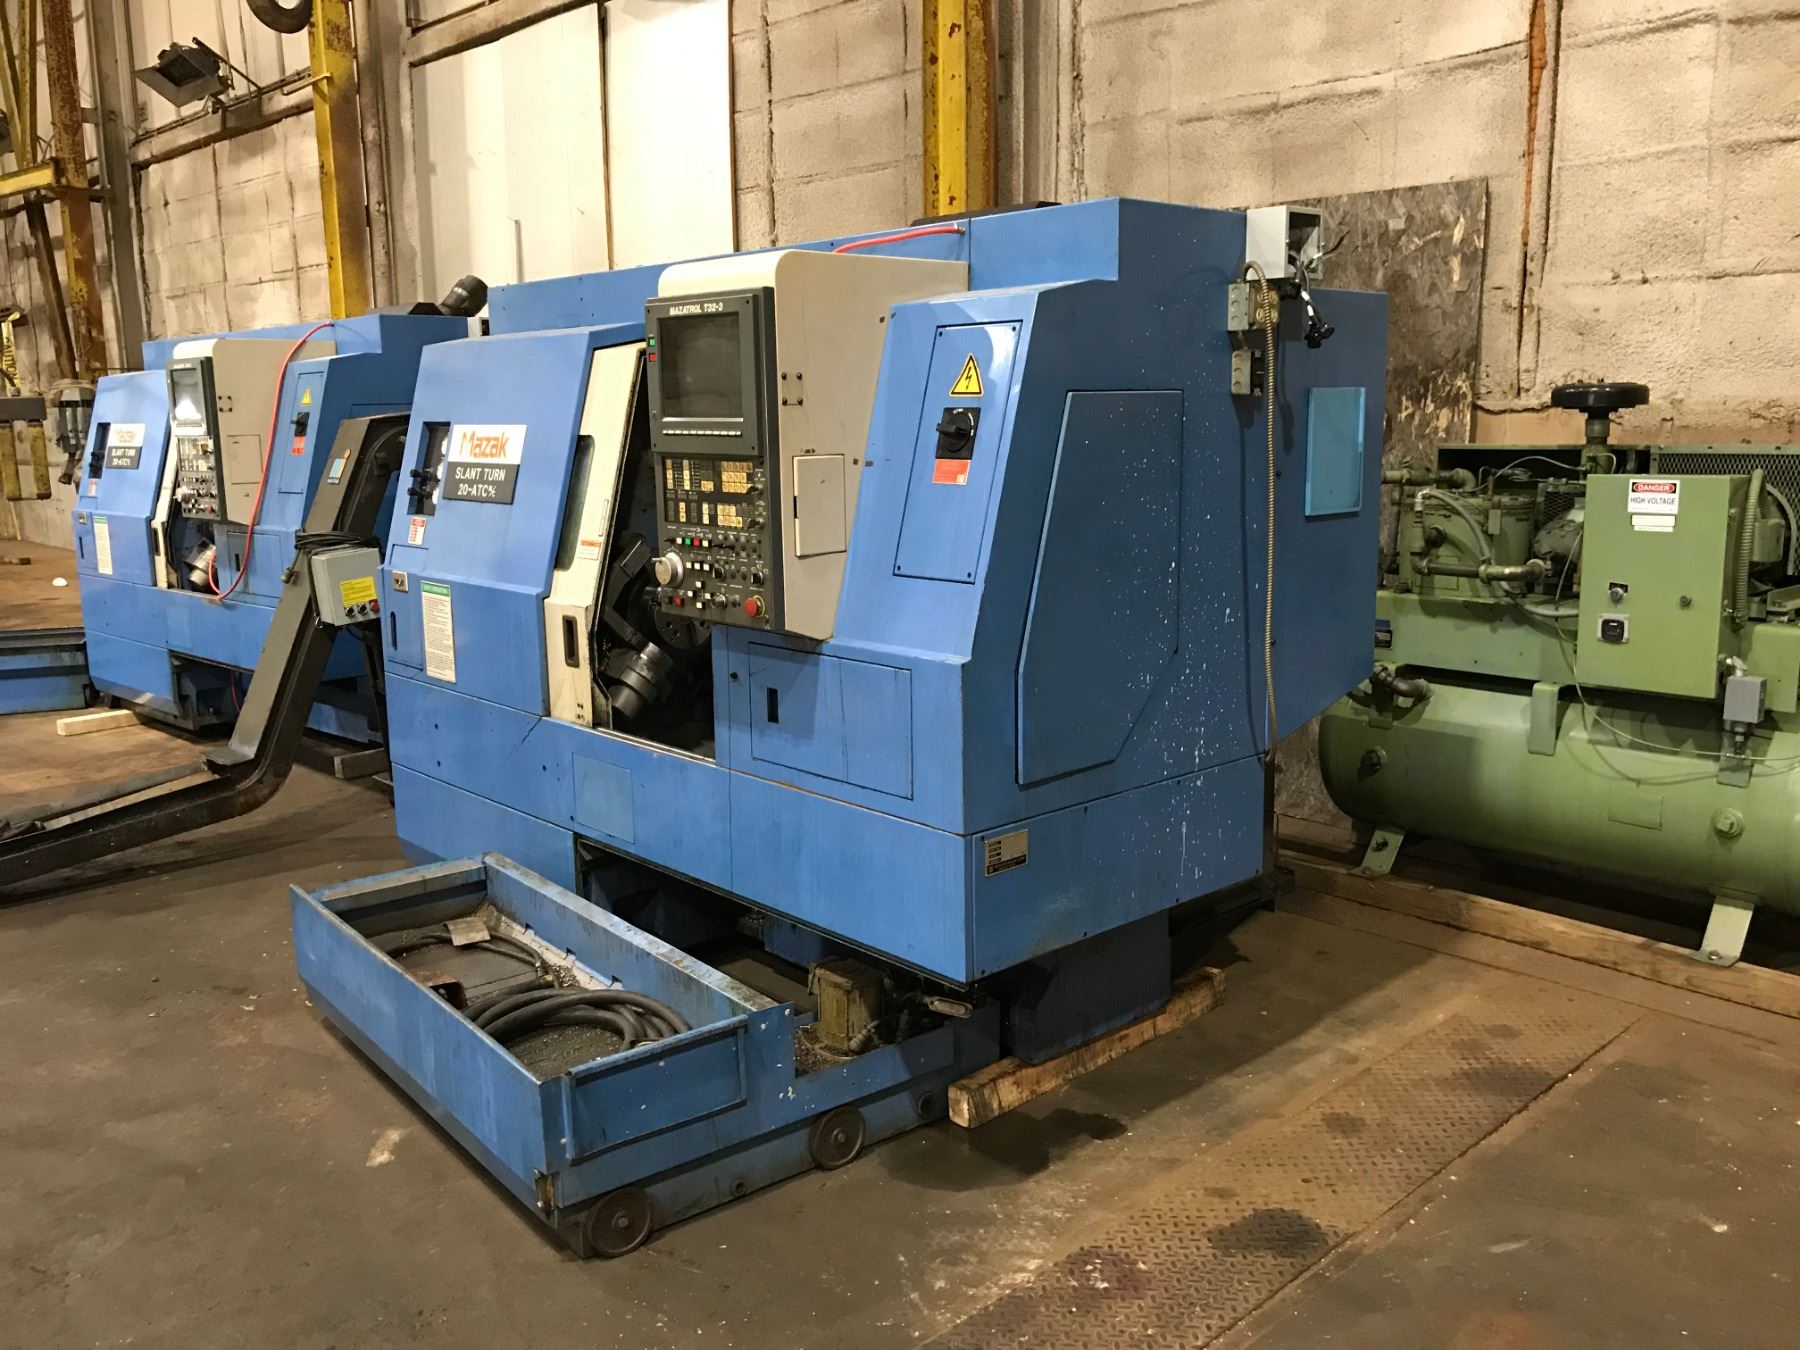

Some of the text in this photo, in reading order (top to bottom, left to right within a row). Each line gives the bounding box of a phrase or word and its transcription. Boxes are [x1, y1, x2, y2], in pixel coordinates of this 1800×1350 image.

[669, 302, 724, 316] MAZATROL T32-3
[461, 430, 510, 459] Mazak
[455, 466, 506, 482] SLANT TURN
[1638, 484, 1670, 492] DANGER
[1630, 496, 1676, 505] HIGH VOLTAGE
